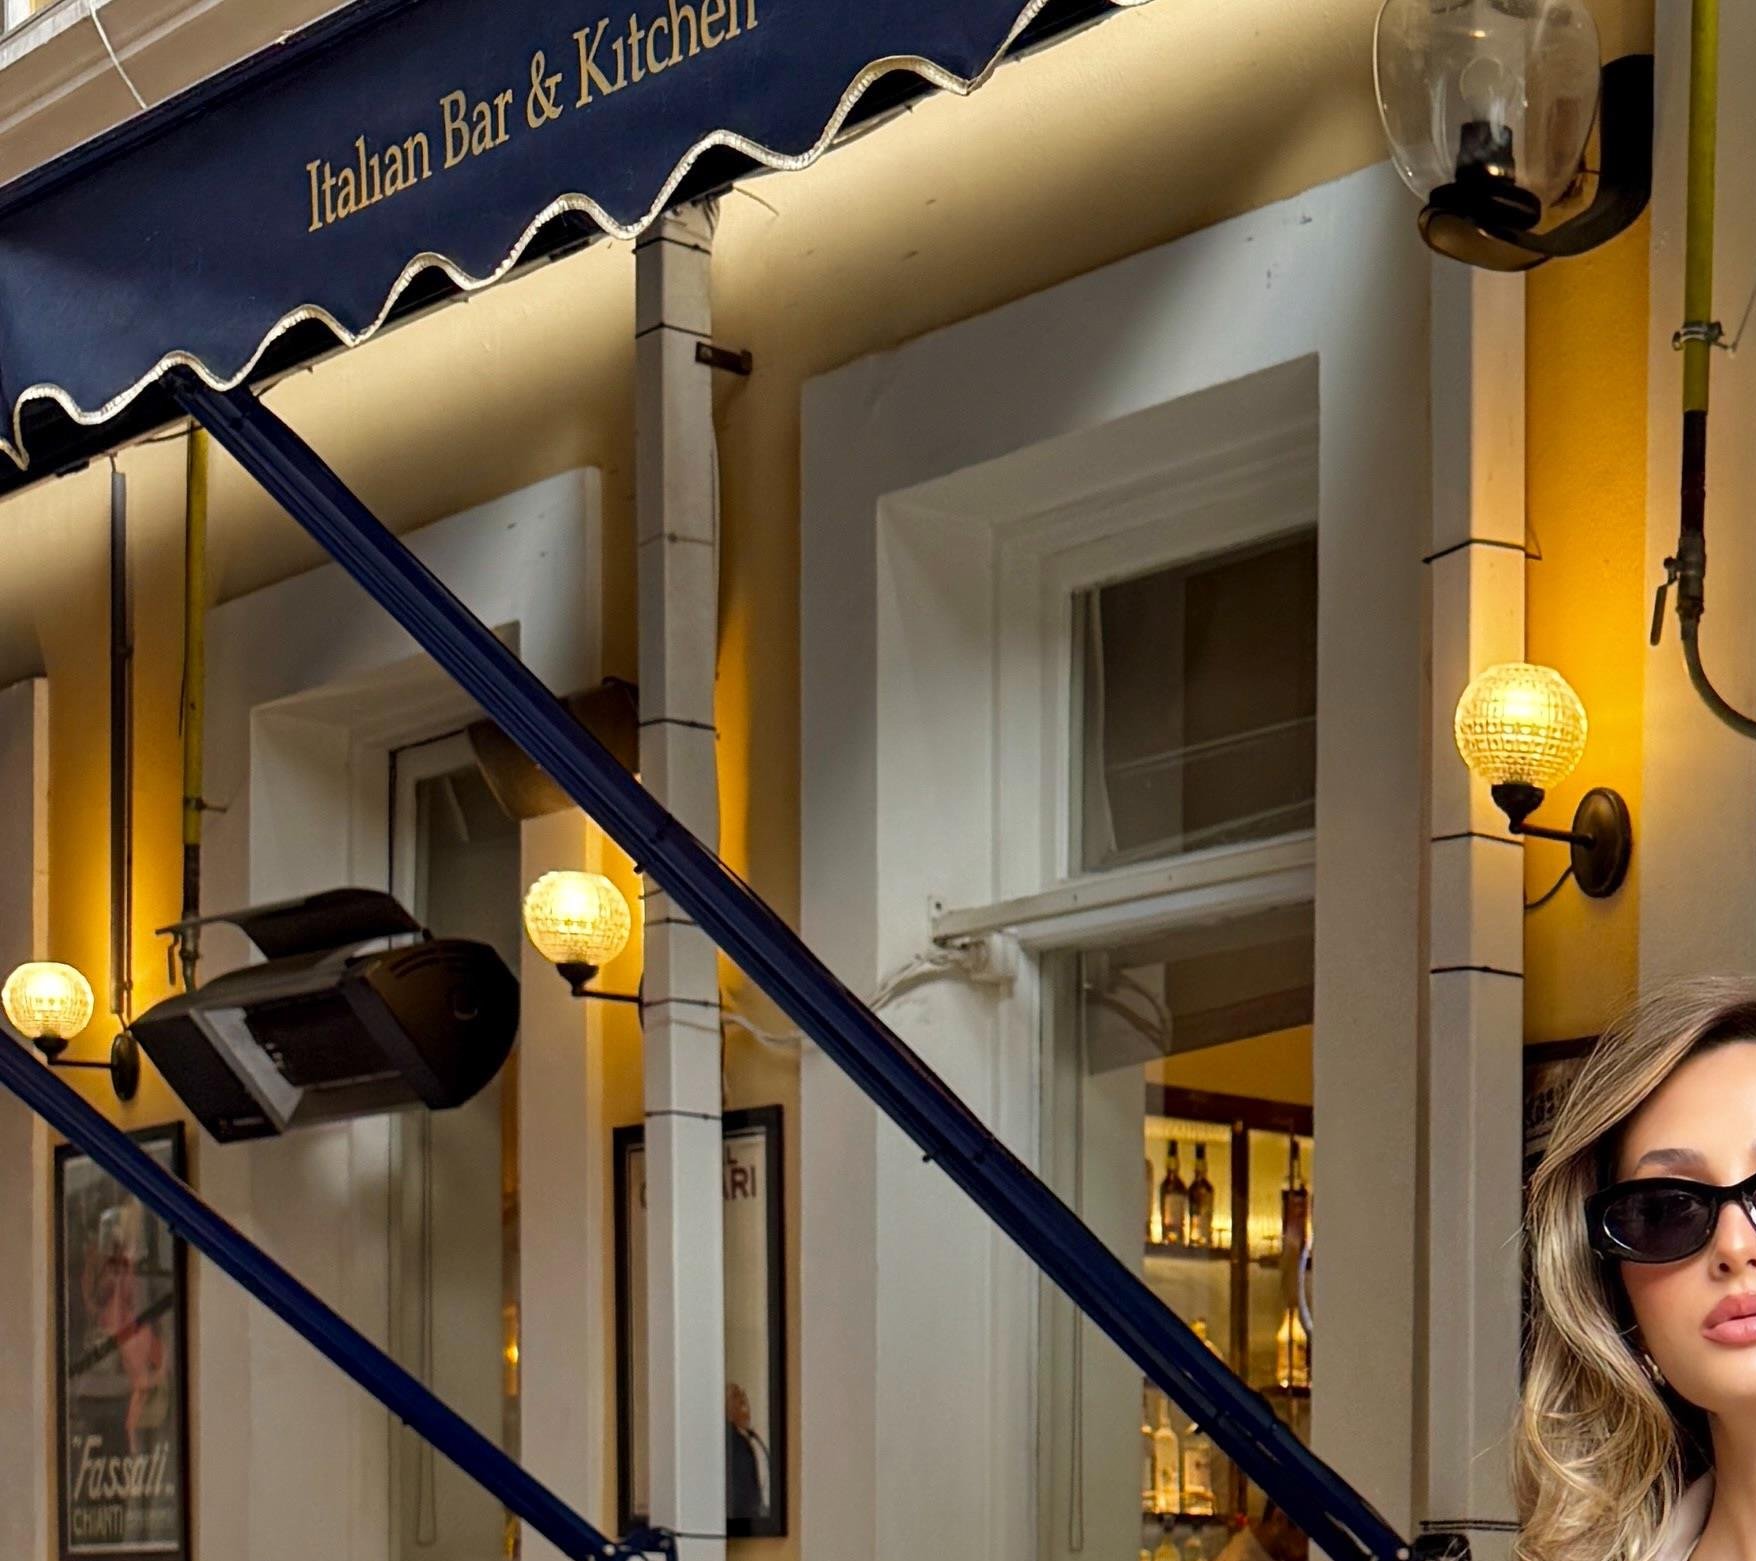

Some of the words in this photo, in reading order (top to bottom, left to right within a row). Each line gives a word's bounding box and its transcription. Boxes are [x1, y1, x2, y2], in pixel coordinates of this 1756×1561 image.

[306, 135, 432, 232] Italian
[440, 89, 513, 170] Bar
[526, 50, 563, 129] &
[573, 0, 758, 108] Kitchen
